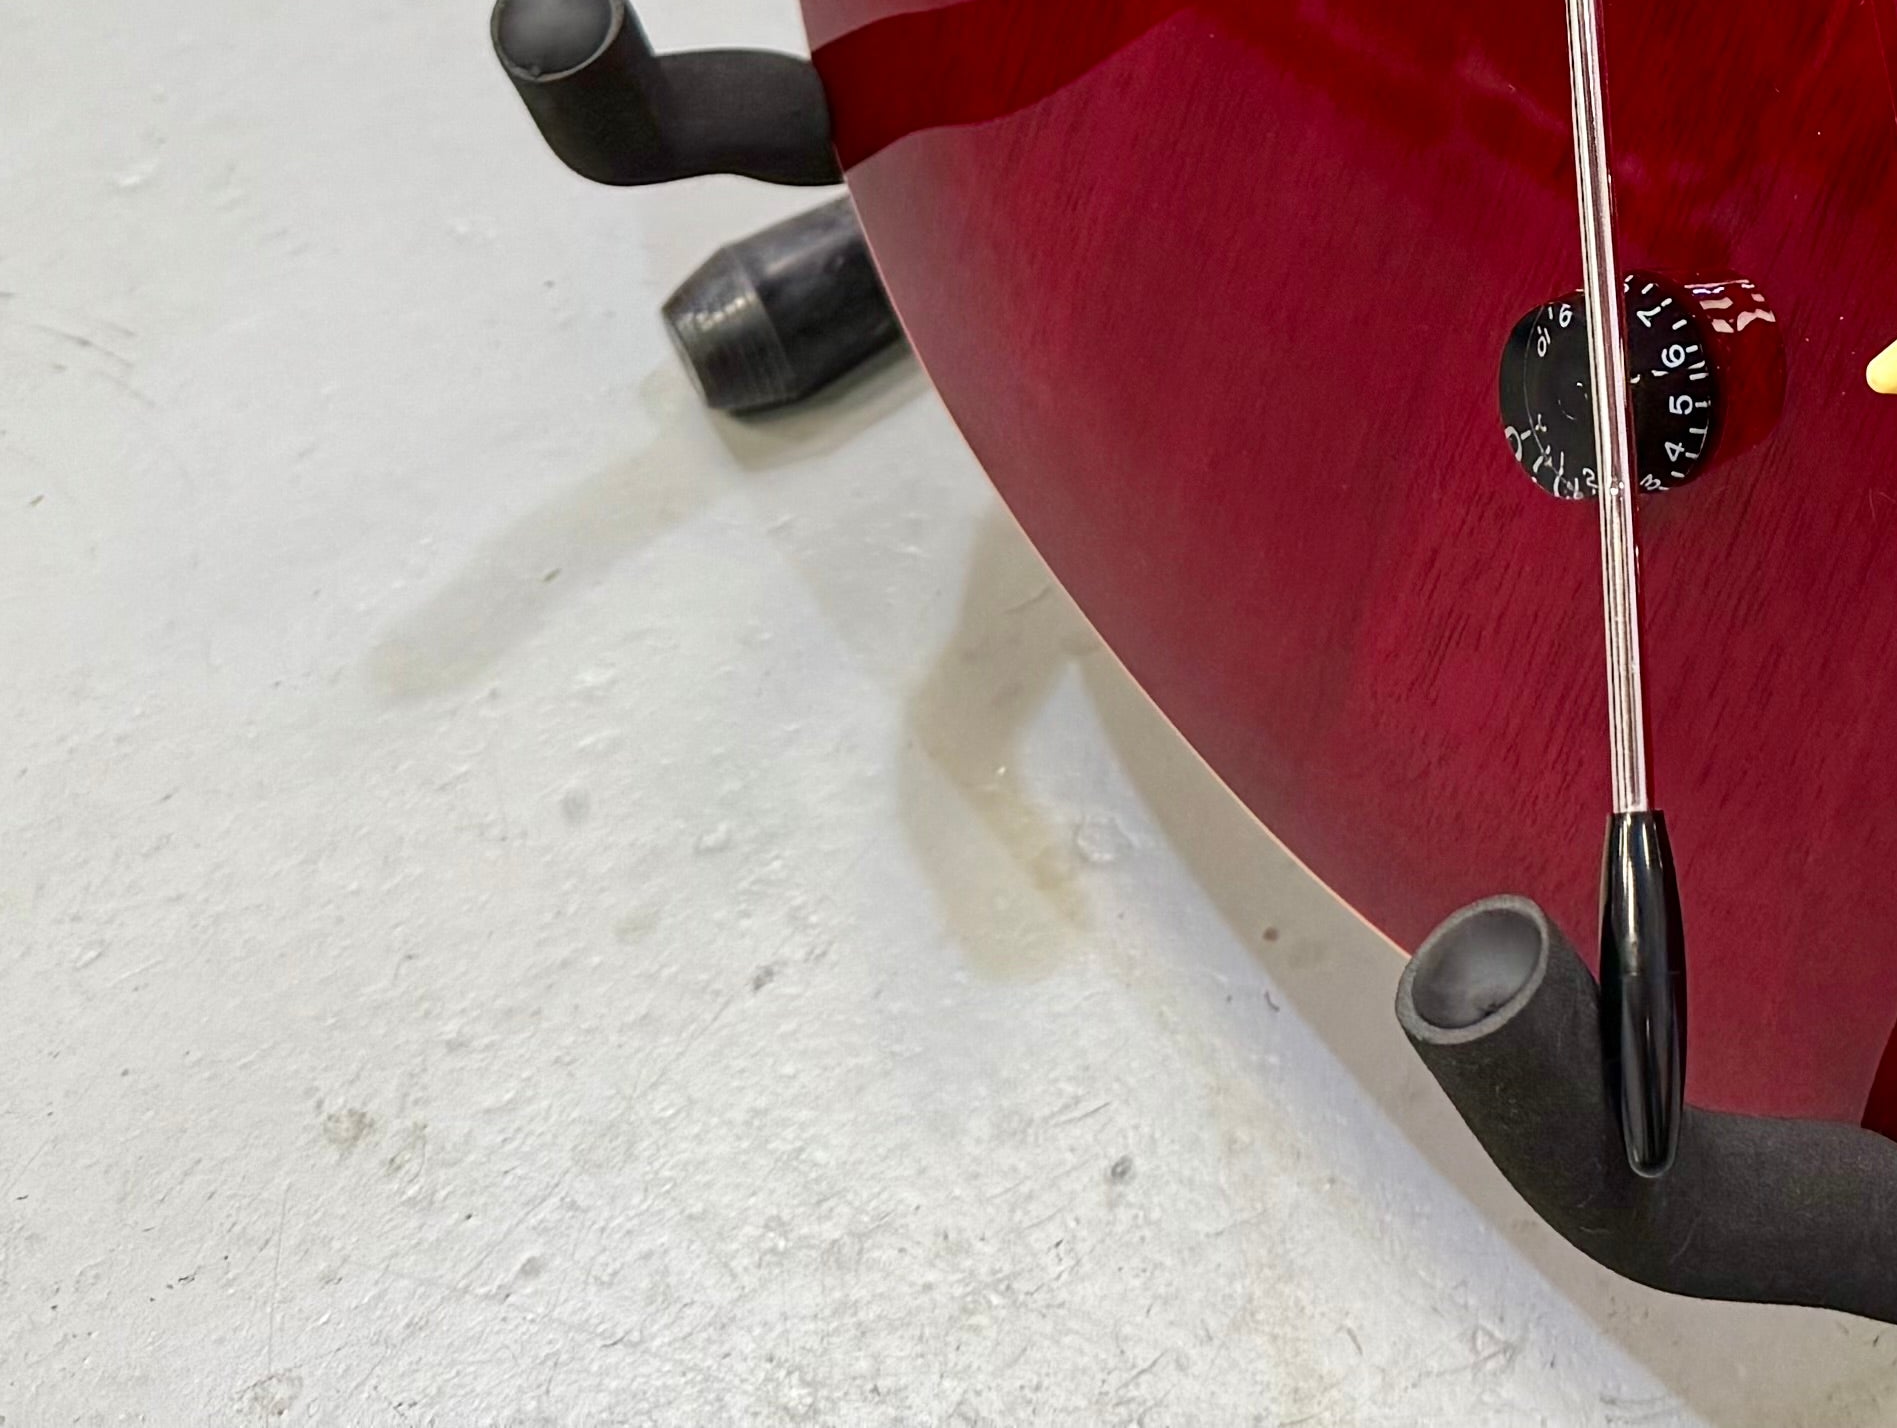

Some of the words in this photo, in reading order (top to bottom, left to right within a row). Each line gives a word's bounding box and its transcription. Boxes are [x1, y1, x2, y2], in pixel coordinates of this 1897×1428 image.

[1636, 306, 1662, 328] 7
[1661, 344, 1686, 368] 6
[1669, 394, 1694, 415] 5
[1664, 441, 1685, 462] 4
[1640, 473, 1662, 490] 3
